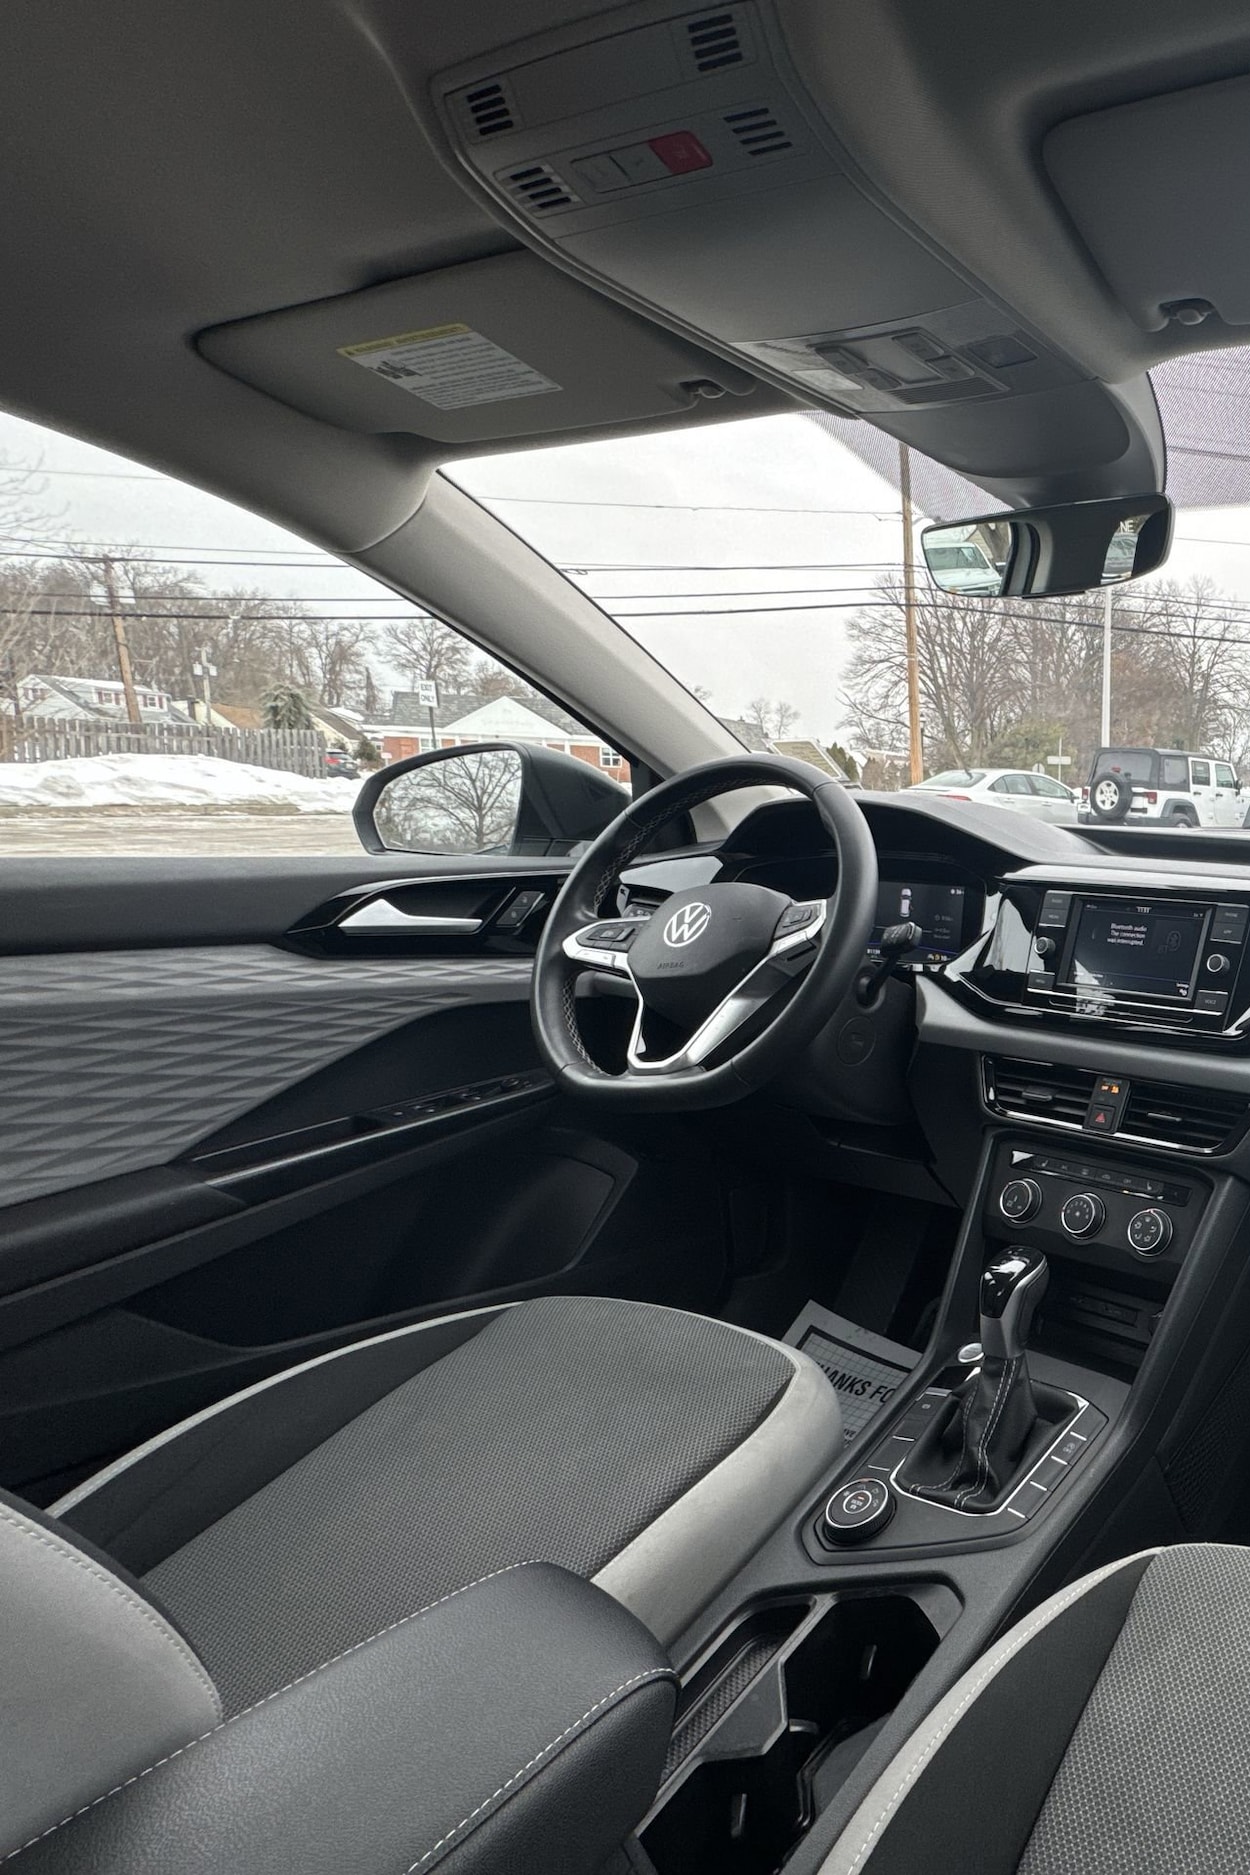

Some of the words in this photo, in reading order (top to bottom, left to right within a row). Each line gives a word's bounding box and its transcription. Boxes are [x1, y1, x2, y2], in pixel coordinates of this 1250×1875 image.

[1120, 520, 1134, 534] NE
[421, 694, 434, 702] ONLY
[816, 1361, 872, 1396] ANKS
